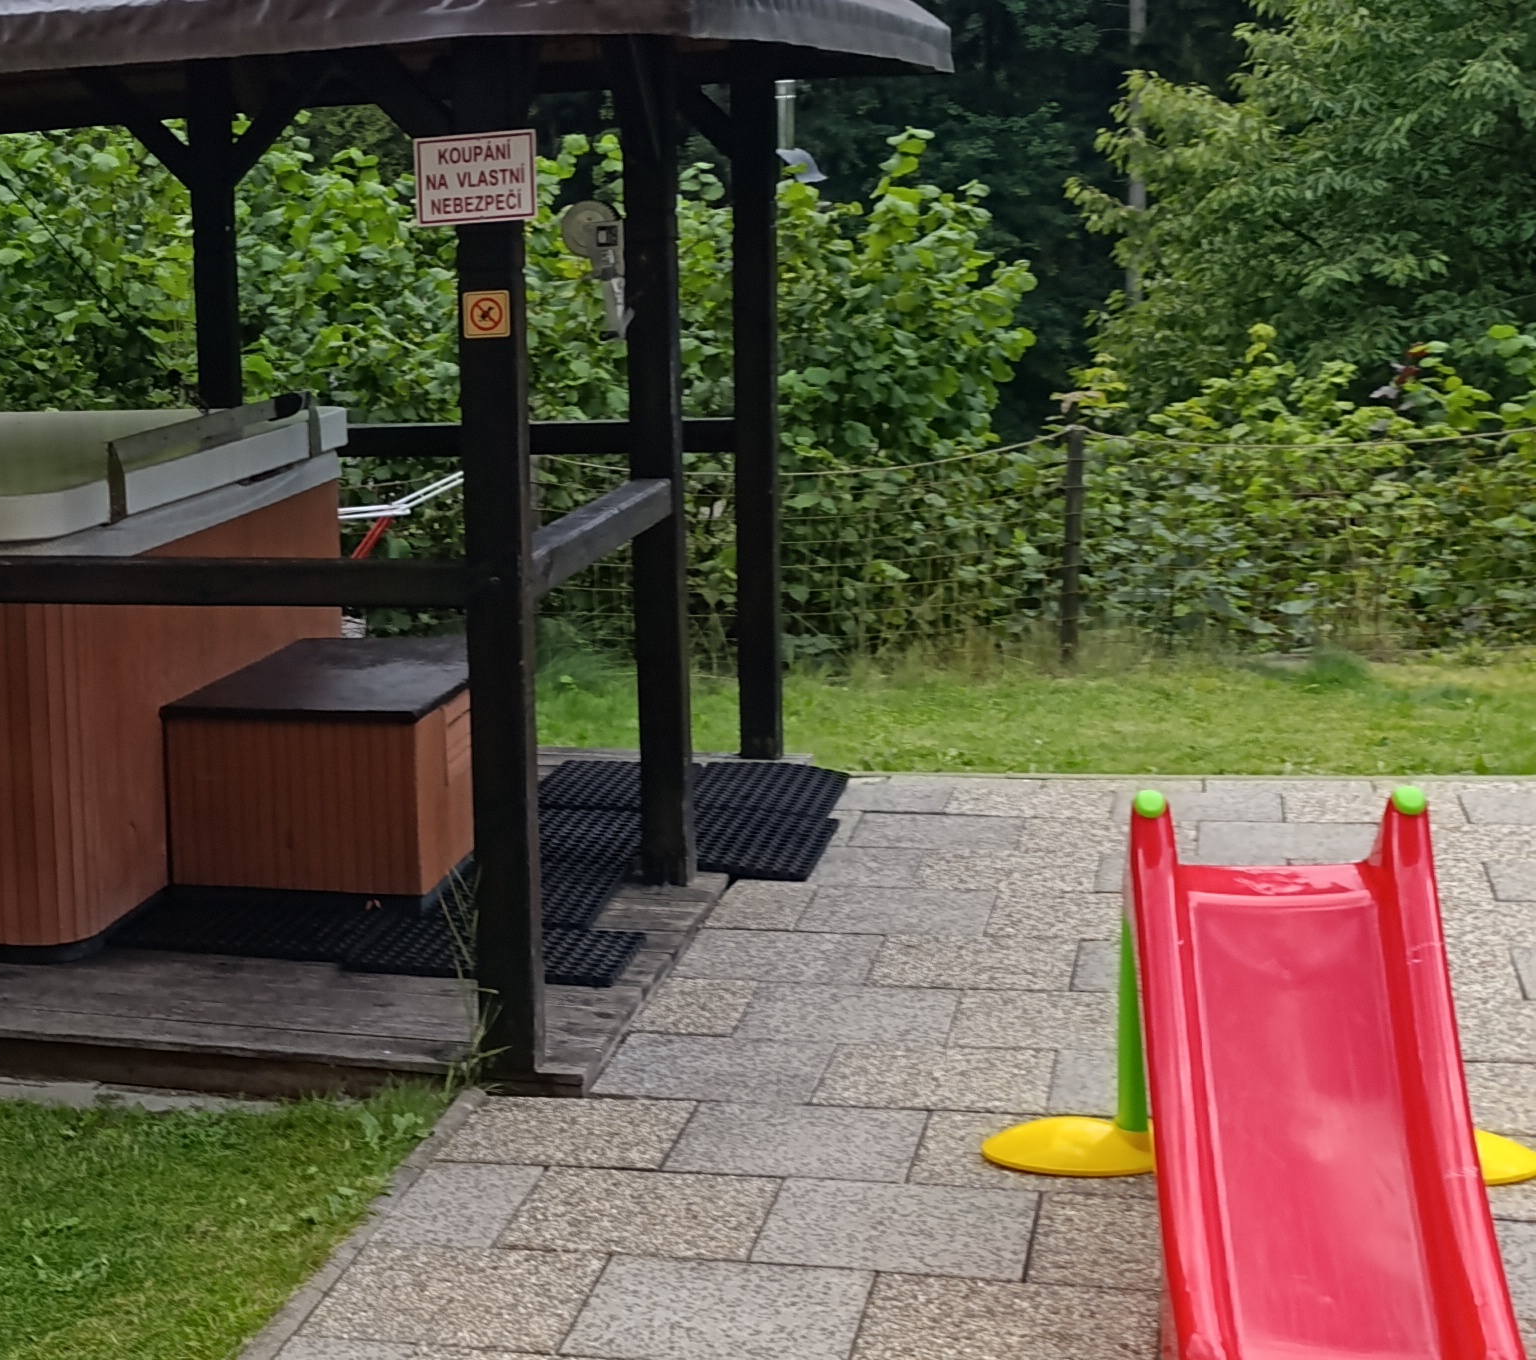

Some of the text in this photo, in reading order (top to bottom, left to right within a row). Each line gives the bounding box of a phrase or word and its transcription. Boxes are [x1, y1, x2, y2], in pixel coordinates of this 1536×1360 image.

[438, 139, 511, 165] KOUPÁNÍ
[426, 163, 525, 191] NA VLASTNÍ
[431, 189, 521, 215] NEBEZPEČÍ
